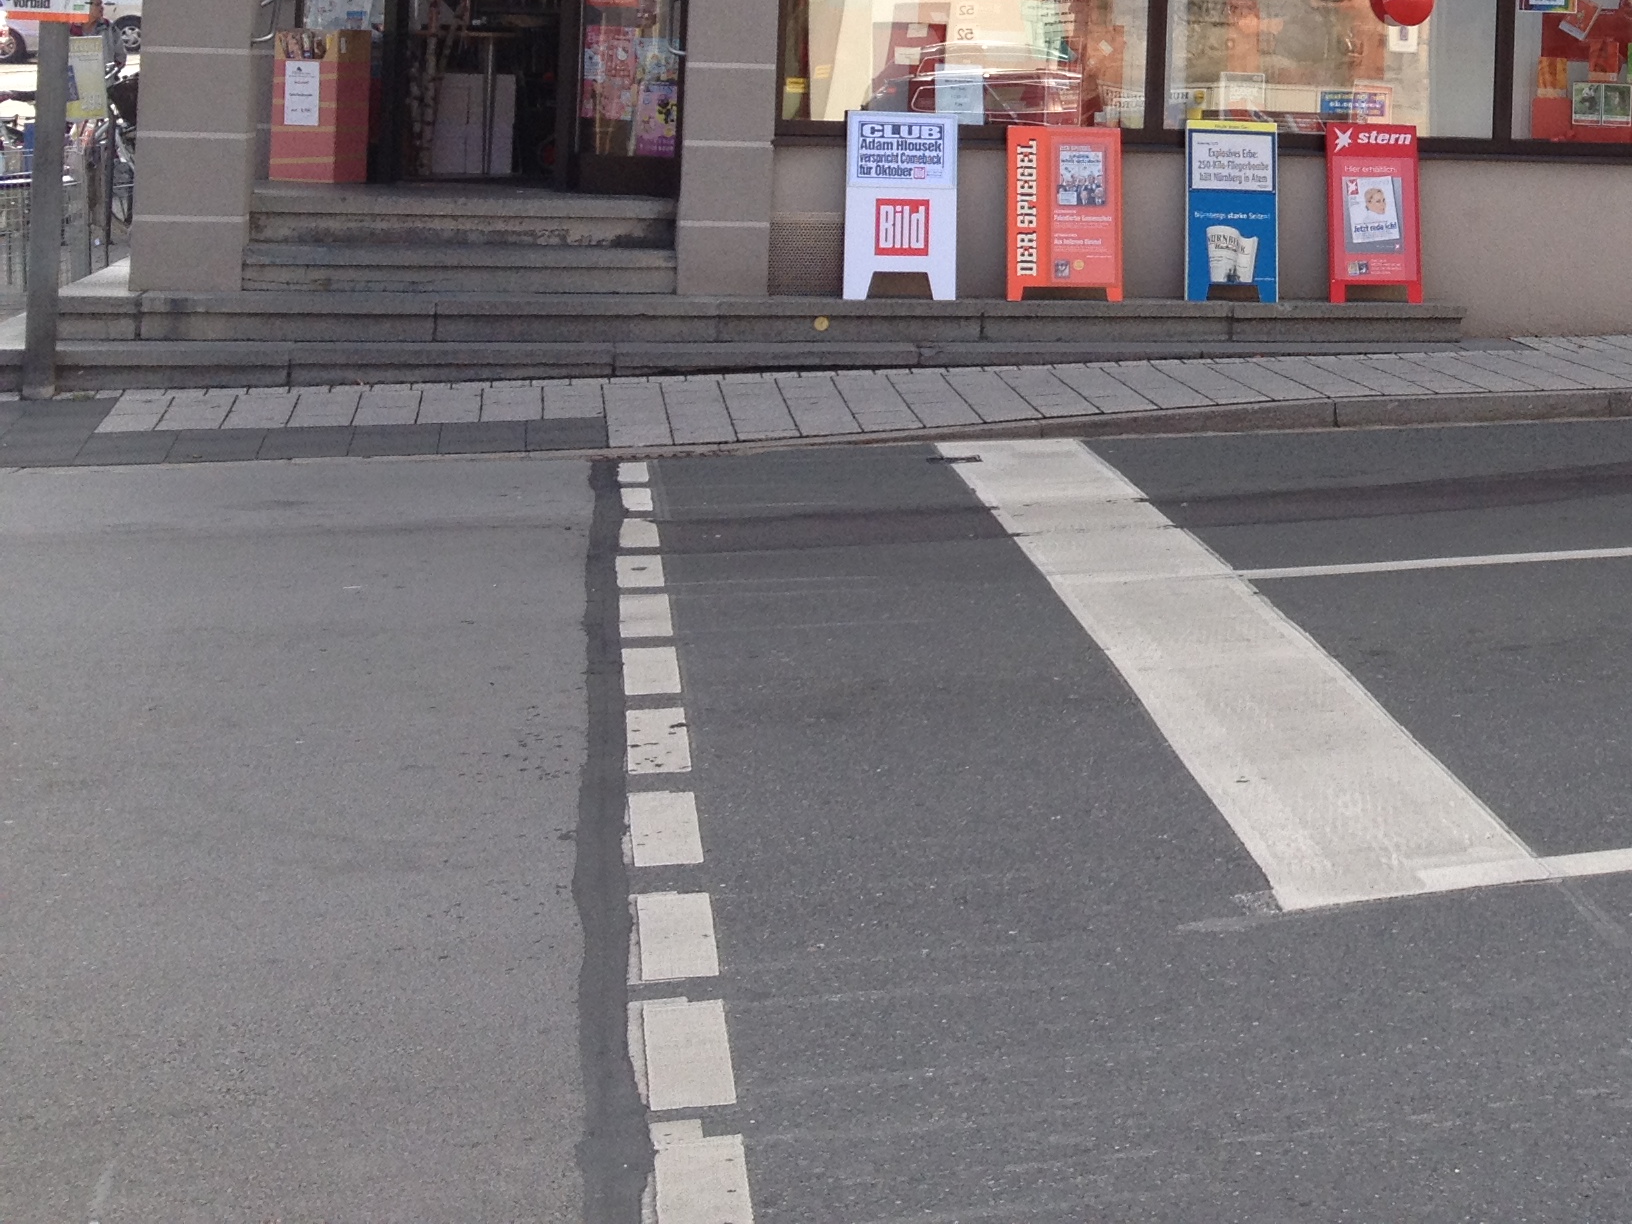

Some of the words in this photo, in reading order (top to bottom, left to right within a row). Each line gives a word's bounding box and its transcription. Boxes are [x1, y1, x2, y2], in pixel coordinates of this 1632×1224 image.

[862, 123, 941, 140] CLUB
[1357, 130, 1412, 145] stern
[860, 138, 893, 151] Adam
[896, 139, 942, 152] Hlousek
[860, 152, 898, 165] verspricht
[900, 152, 941, 165] Comeback
[1208, 148, 1241, 159] Explosives
[860, 164, 873, 176] für
[875, 165, 913, 177] Oktober
[1017, 138, 1037, 228] SPIEGEL
[1214, 173, 1242, 184] Nürnberg
[1244, 173, 1250, 182] in
[1251, 174, 1268, 182] Atem
[879, 205, 926, 249] Bild
[1354, 224, 1369, 233] Jetzt
[1370, 224, 1384, 232] rede
[1017, 231, 1037, 276] DER
